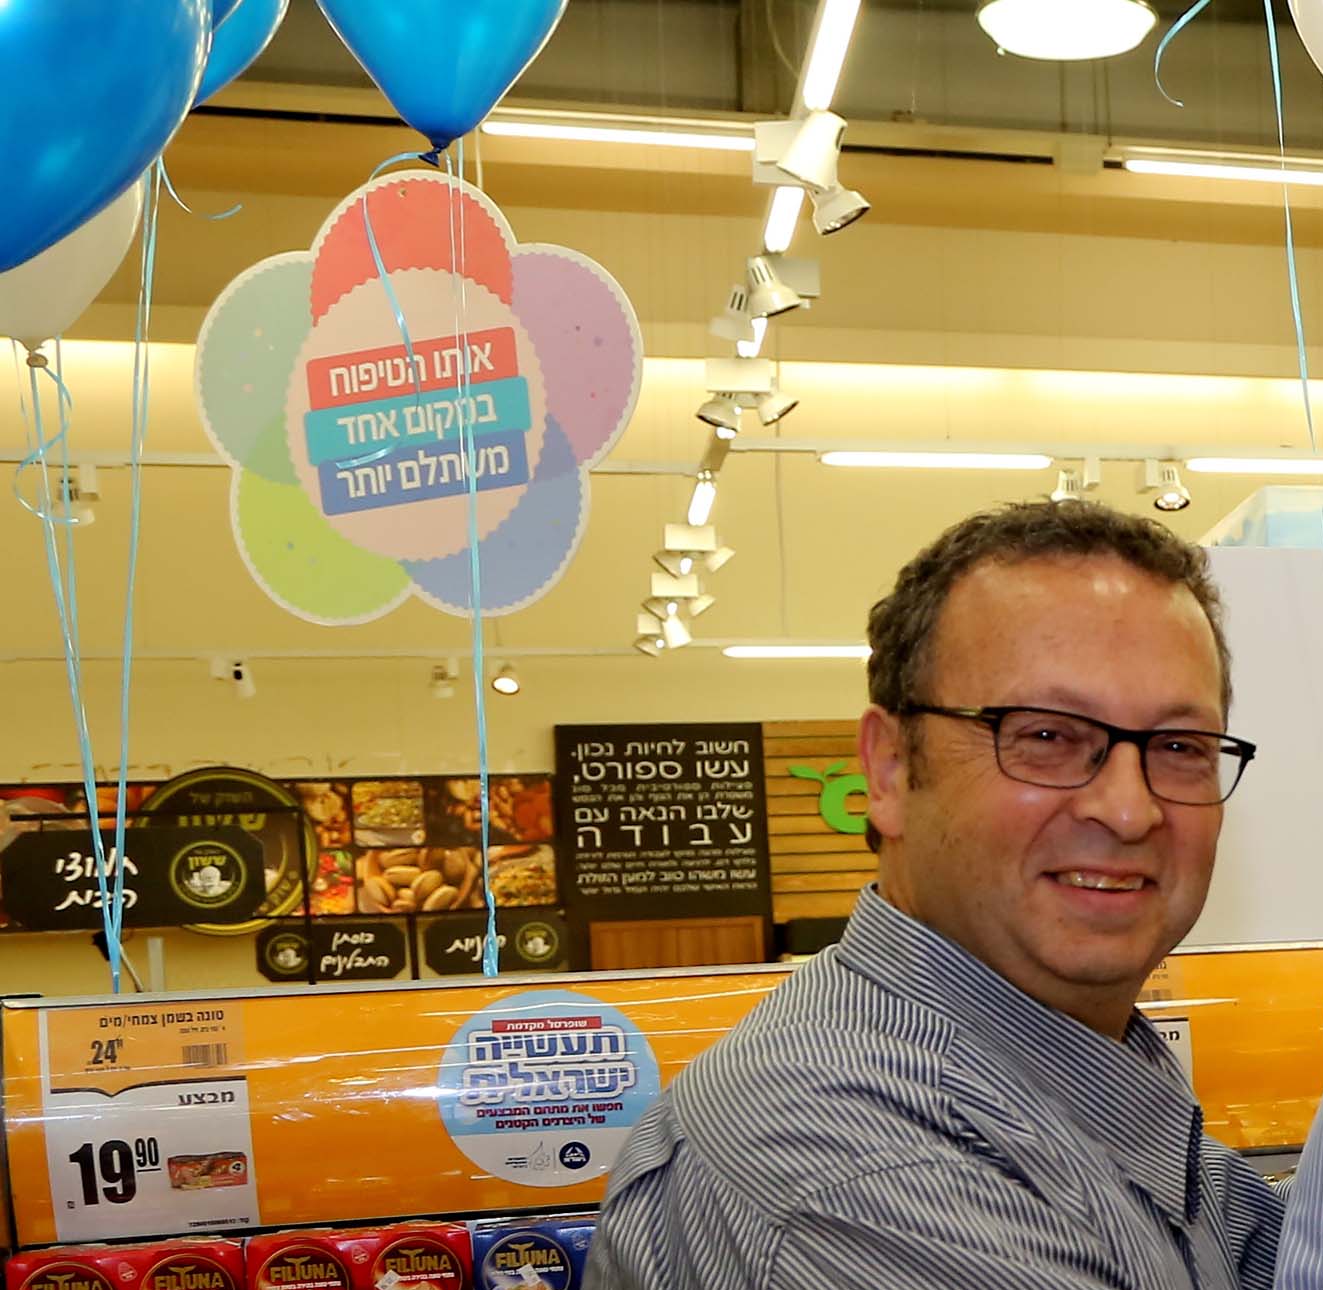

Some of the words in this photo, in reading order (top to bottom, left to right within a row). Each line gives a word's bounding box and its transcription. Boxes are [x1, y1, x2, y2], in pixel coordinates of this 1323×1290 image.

[429, 345, 494, 380] אותו
[329, 355, 427, 398] הטיפוח
[336, 410, 397, 442] אחד
[402, 394, 497, 437] במקום
[400, 442, 510, 490] משתלם
[336, 465, 394, 499] יותר
[624, 739, 687, 756] לחיות
[694, 740, 750, 756] חשוב
[696, 759, 750, 778] עשו
[574, 806, 610, 824] עם
[620, 804, 687, 822] הנאה
[696, 801, 754, 820] שלבו
[196, 1009, 224, 1021] טונה
[475, 1031, 620, 1060] תעשייה
[178, 1090, 235, 1106] מבצע
[69, 1139, 138, 1206] 19
[135, 1136, 160, 1168] 90
[496, 1242, 561, 1267] FILTUNA
[270, 1255, 338, 1284] FILTUNA
